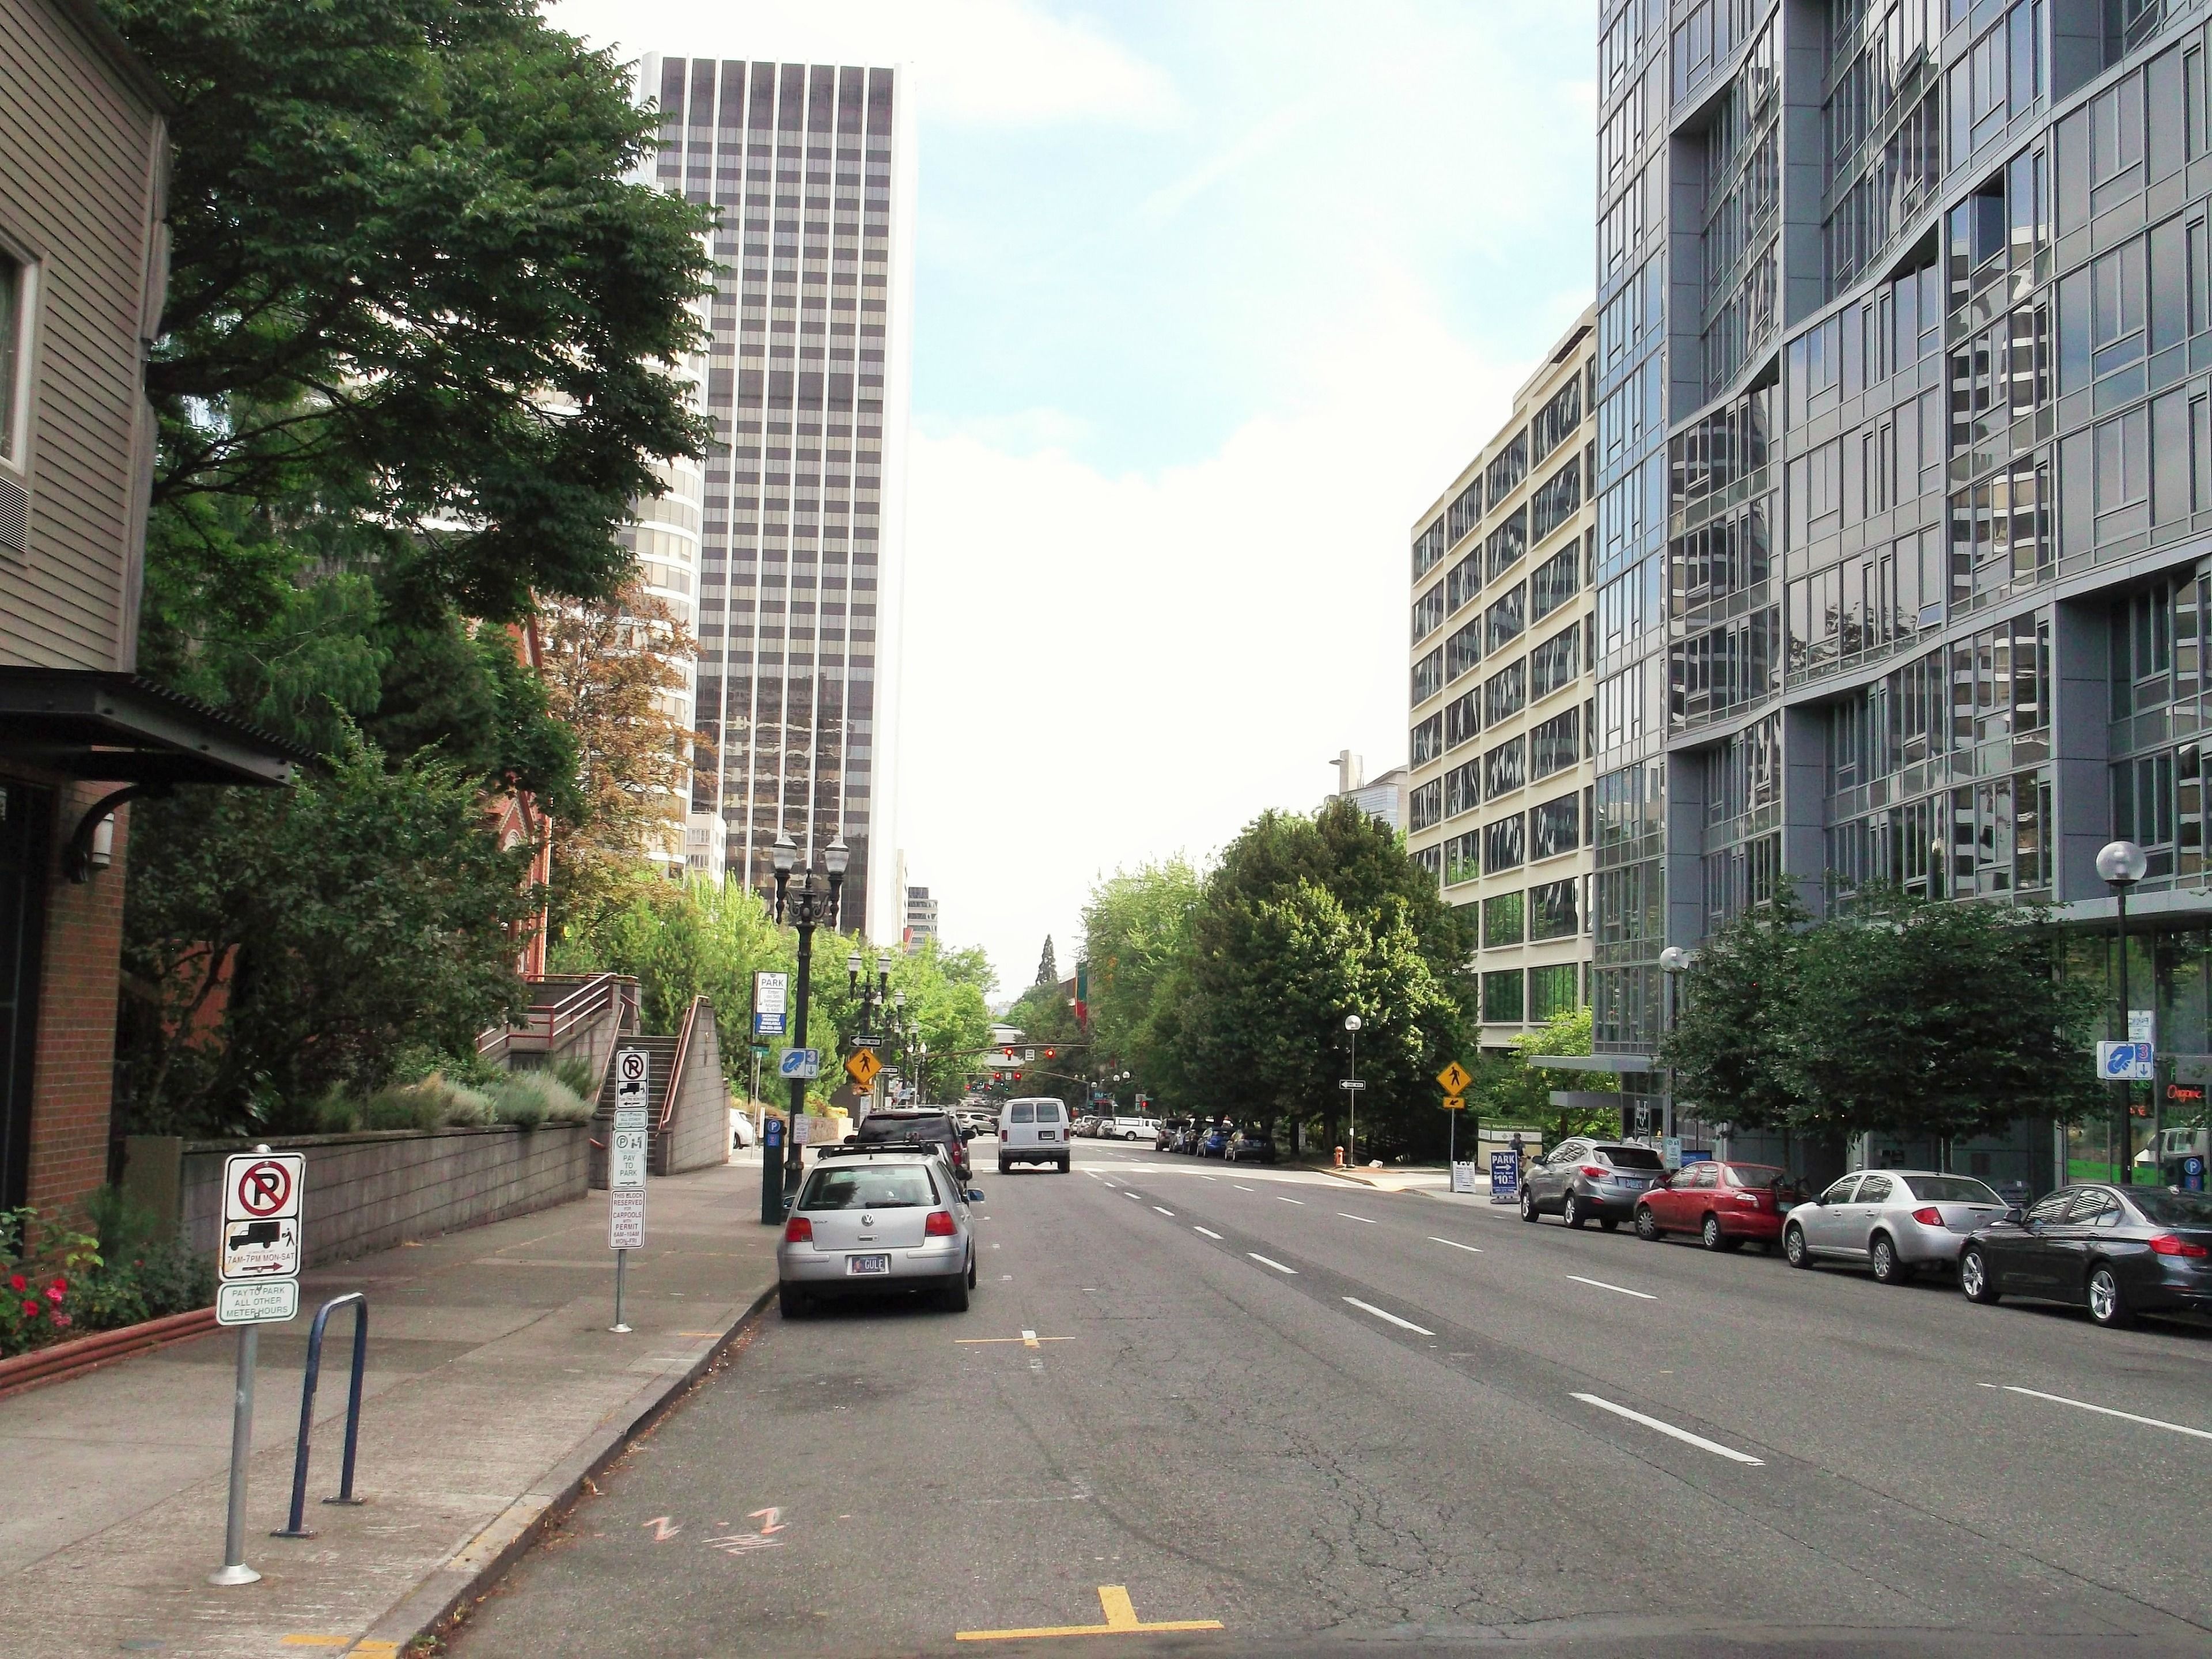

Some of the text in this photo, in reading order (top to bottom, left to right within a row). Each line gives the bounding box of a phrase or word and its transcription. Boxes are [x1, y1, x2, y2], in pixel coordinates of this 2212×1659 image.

[807, 1051, 816, 1062] 3
[2138, 1044, 2149, 1059] 3
[771, 1122, 777, 1130] P
[1492, 1155, 1515, 1164] PARK
[2190, 1161, 2197, 1172] P
[228, 1253, 294, 1263] 7AM-7PM MON-SAT
[254, 1297, 282, 1305] OTHER
[227, 1306, 288, 1317] METER HOURS
